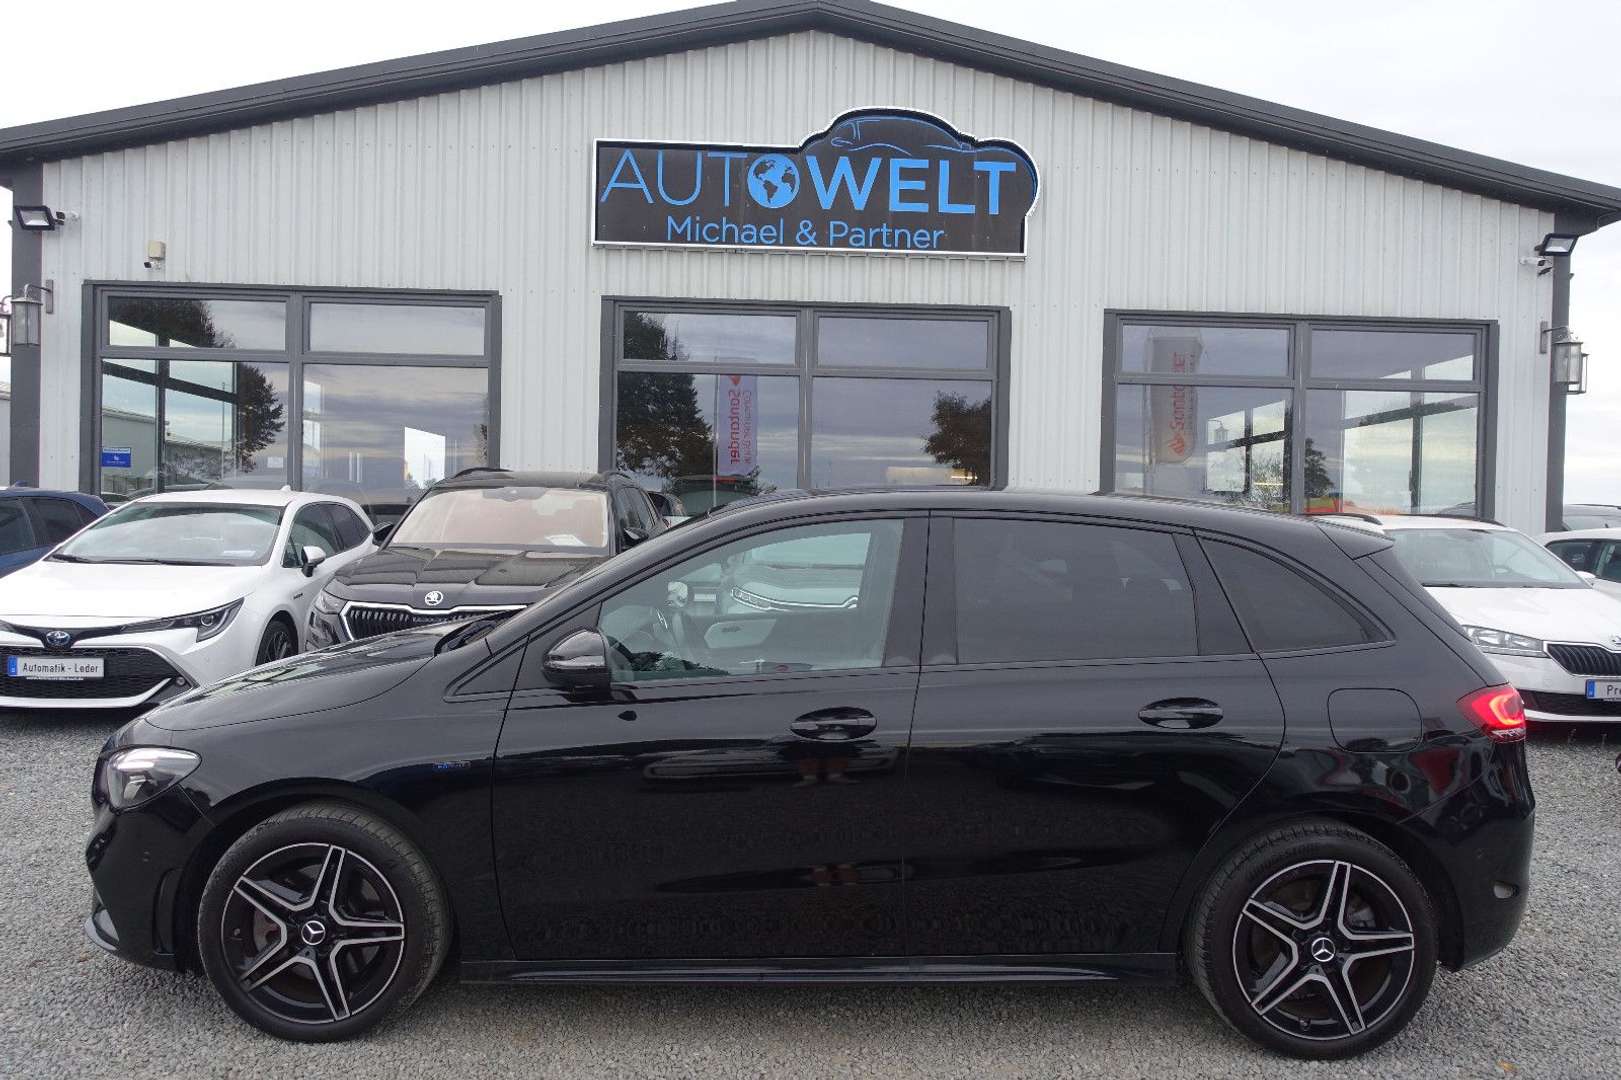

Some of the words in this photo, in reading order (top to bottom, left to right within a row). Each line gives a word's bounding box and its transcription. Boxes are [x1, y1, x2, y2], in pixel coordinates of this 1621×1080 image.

[666, 215, 786, 246] Michael
[796, 220, 818, 246] &
[828, 220, 945, 249] Partner
[22, 662, 66, 674] Automatik
[74, 663, 99, 674] Leder
